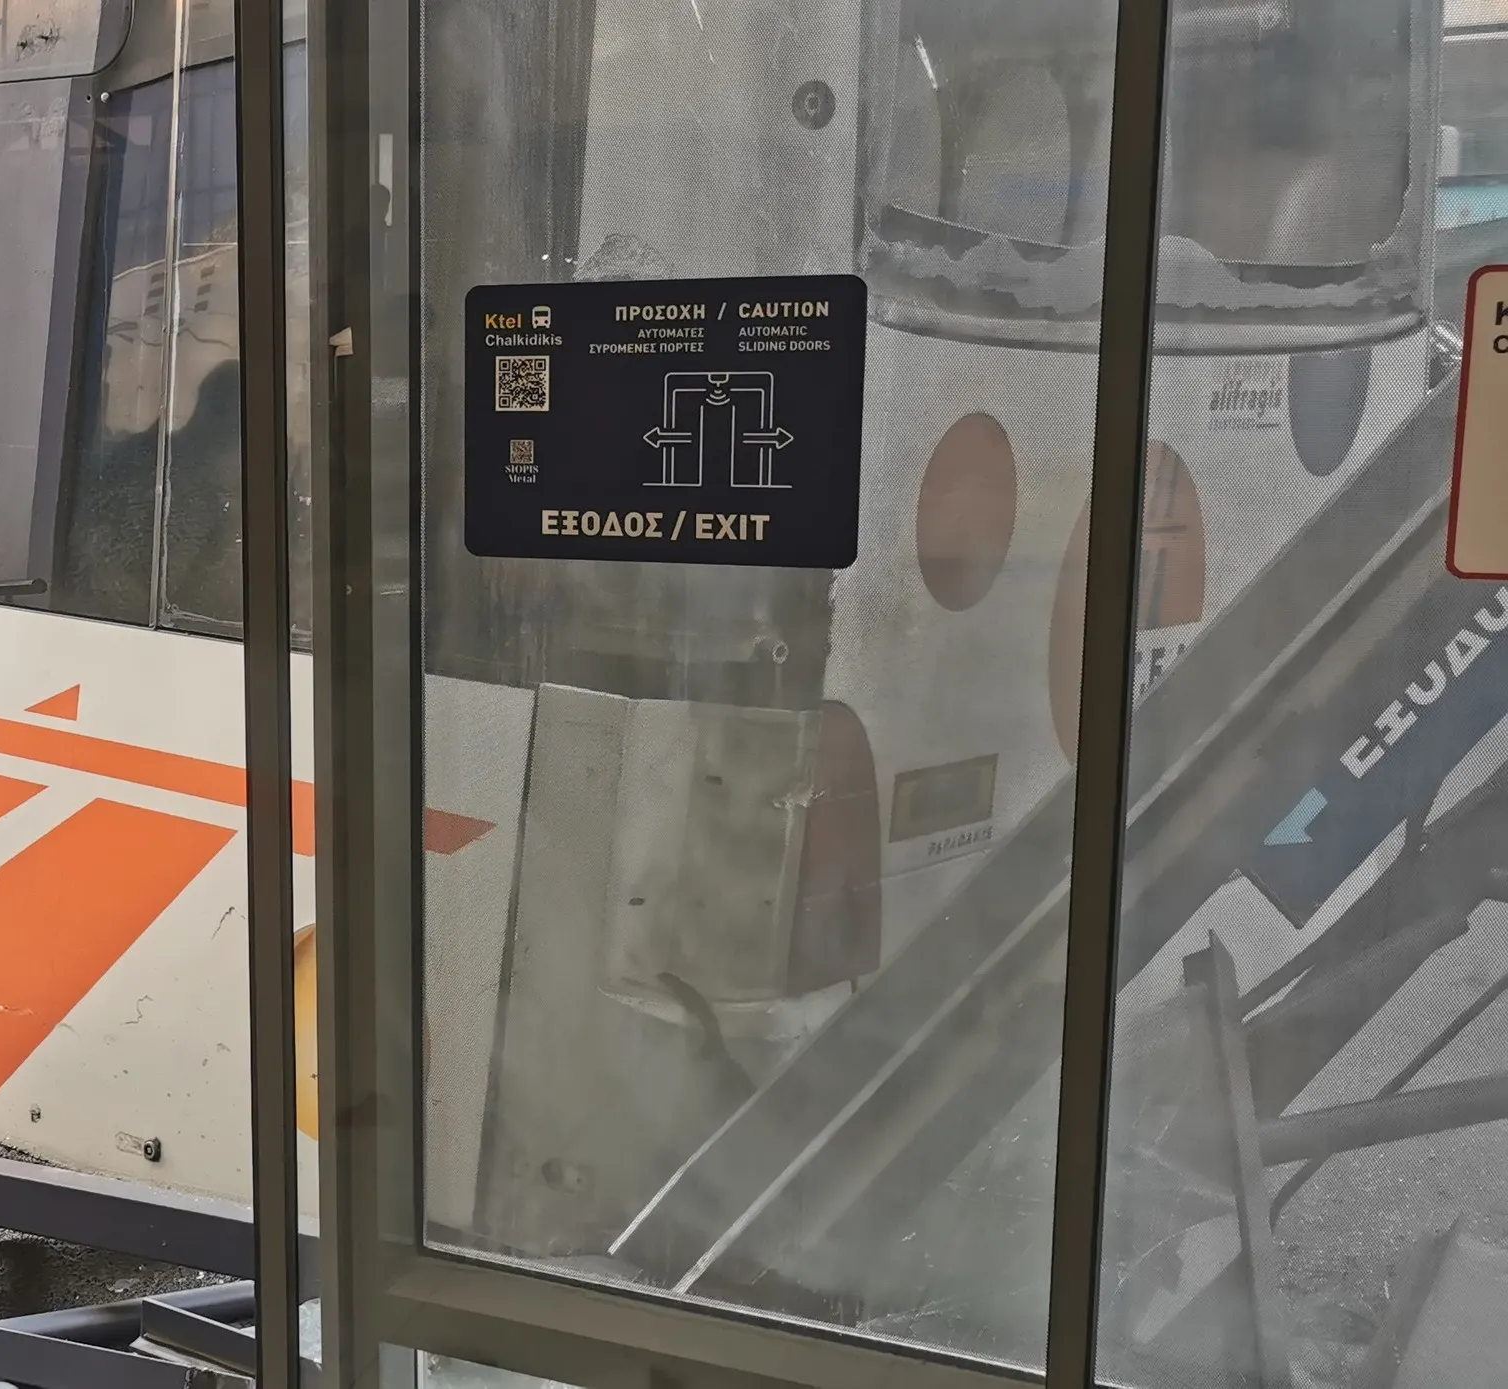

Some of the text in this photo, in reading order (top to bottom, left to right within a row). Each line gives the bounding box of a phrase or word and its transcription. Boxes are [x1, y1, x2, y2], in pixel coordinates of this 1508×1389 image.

[615, 301, 829, 322] ΠΡΟΣΟΧΗ / CAUTION
[485, 313, 522, 329] Ktel
[637, 328, 704, 339] ΑΥΤΟΜΑΤΕΣ
[738, 326, 808, 337] AUTOMATIC
[485, 333, 563, 347] Chalkidikis
[738, 340, 831, 352] SLIDING DOORS
[589, 342, 704, 354] ΣΥΡΟΜΕΝΕΣ ΠΟΡΤΕΣ
[542, 509, 770, 541] ΕΞΟΔΟΣ / EXIT
